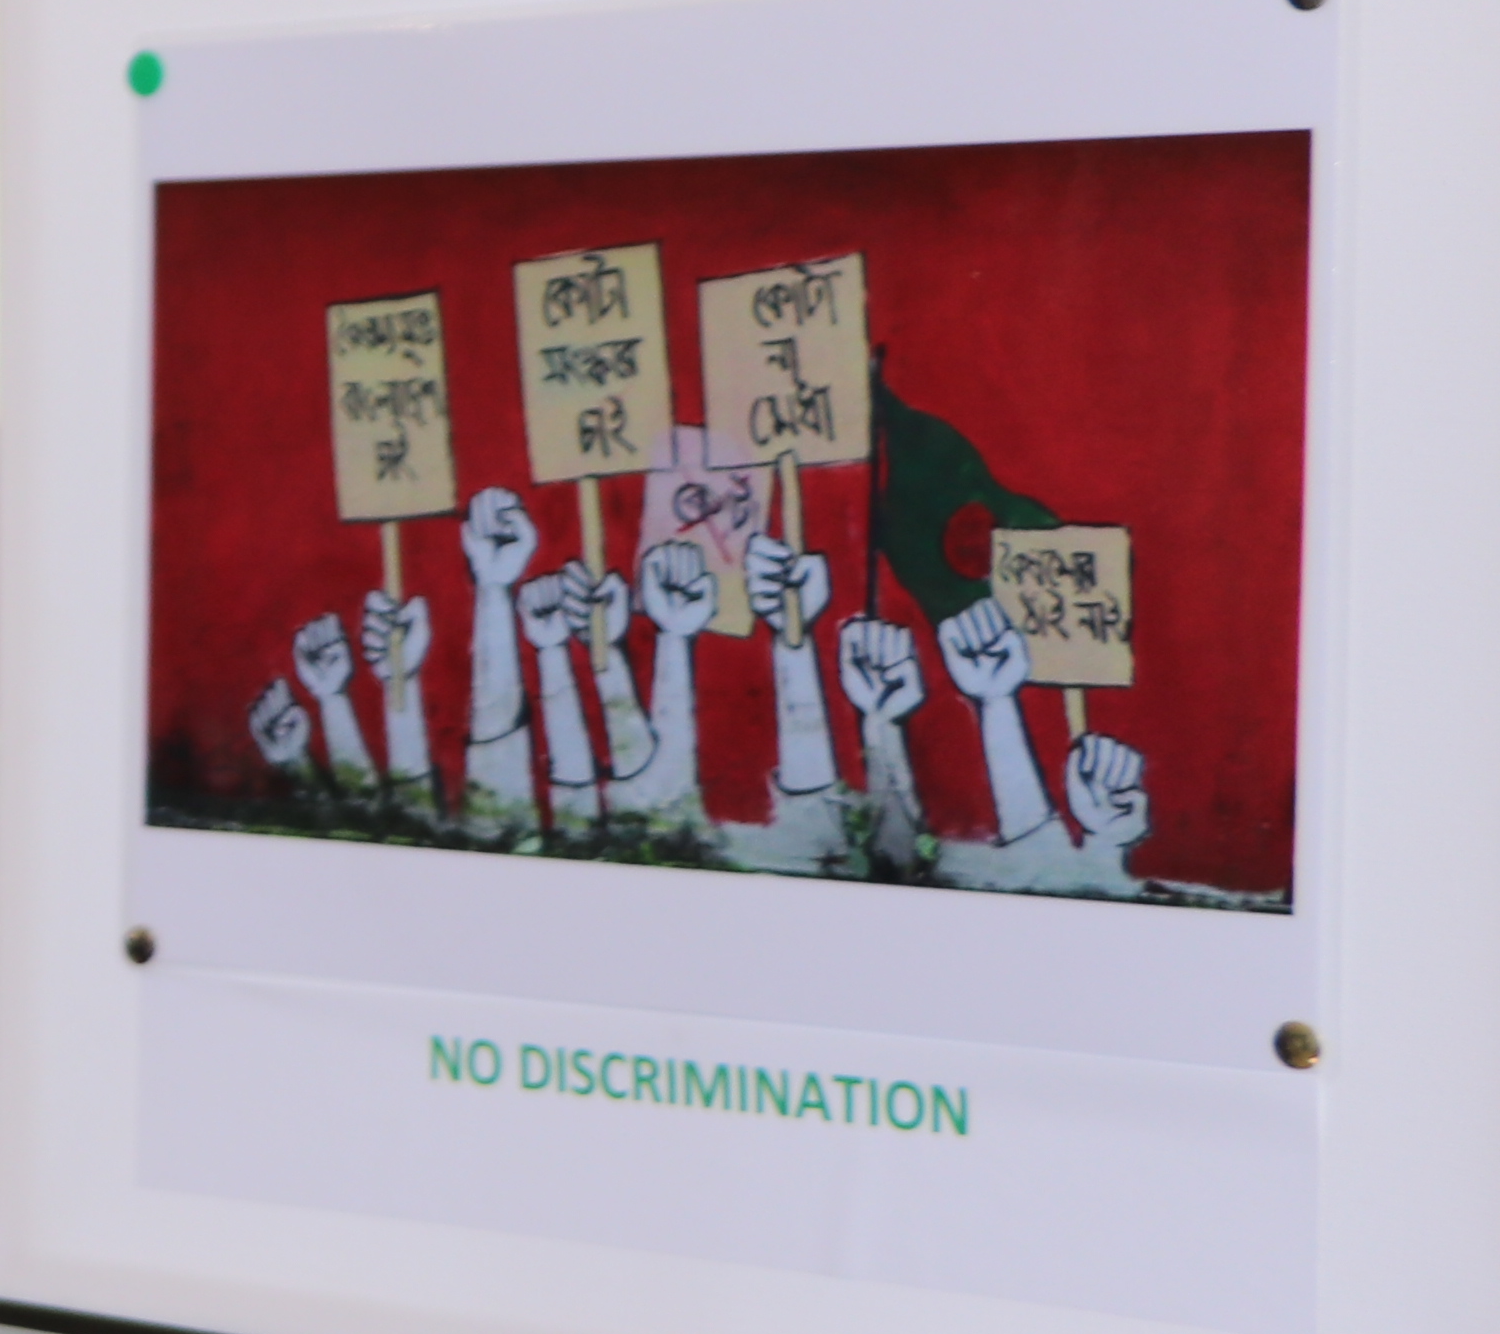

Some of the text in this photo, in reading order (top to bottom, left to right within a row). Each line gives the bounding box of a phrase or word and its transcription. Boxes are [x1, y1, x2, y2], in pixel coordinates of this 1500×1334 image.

[543, 252, 629, 327] কোটা
[577, 396, 638, 458] চাই
[429, 1035, 969, 1135] NO DISCRIMINATION
